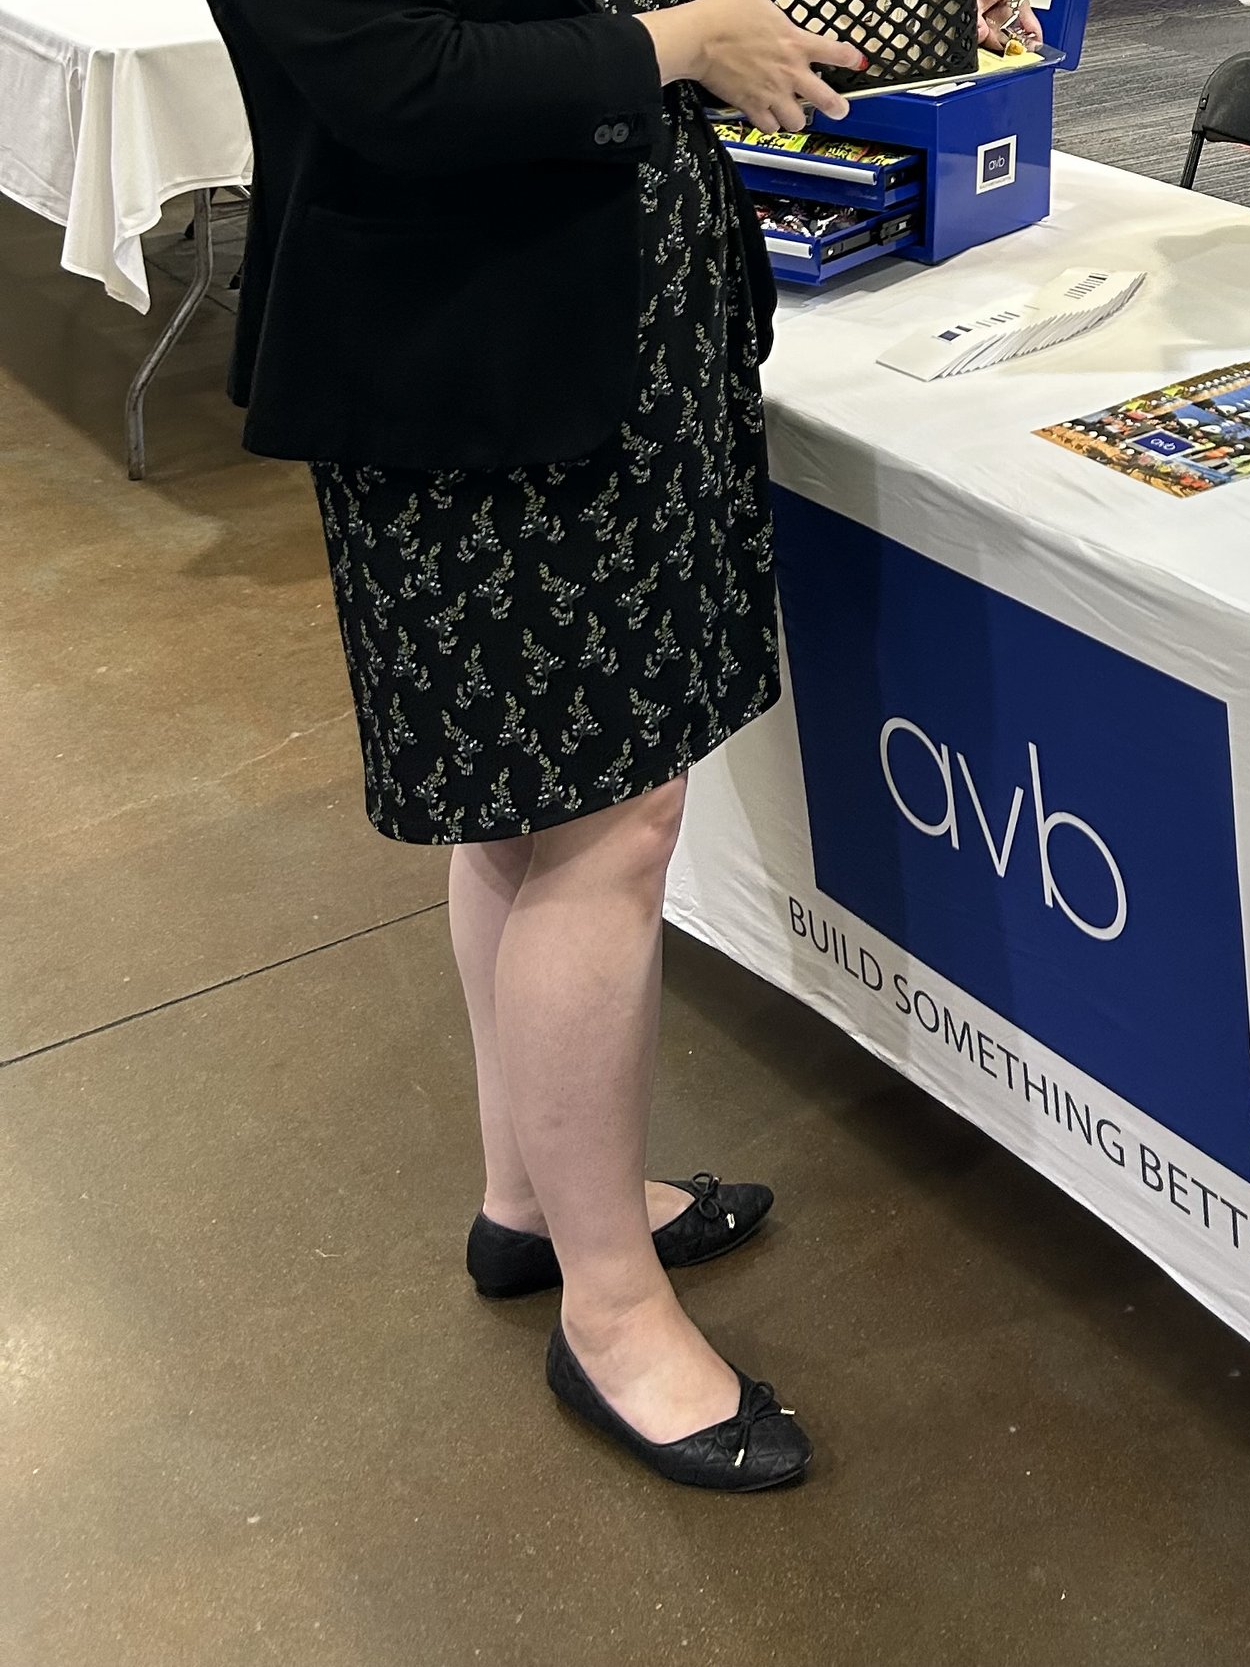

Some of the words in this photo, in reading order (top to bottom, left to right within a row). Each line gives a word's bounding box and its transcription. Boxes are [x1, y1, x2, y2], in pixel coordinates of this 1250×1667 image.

[988, 154, 1005, 171] avb
[879, 717, 1127, 941] avb
[789, 896, 883, 991] BUILD
[893, 974, 1125, 1167] SOMETHING
